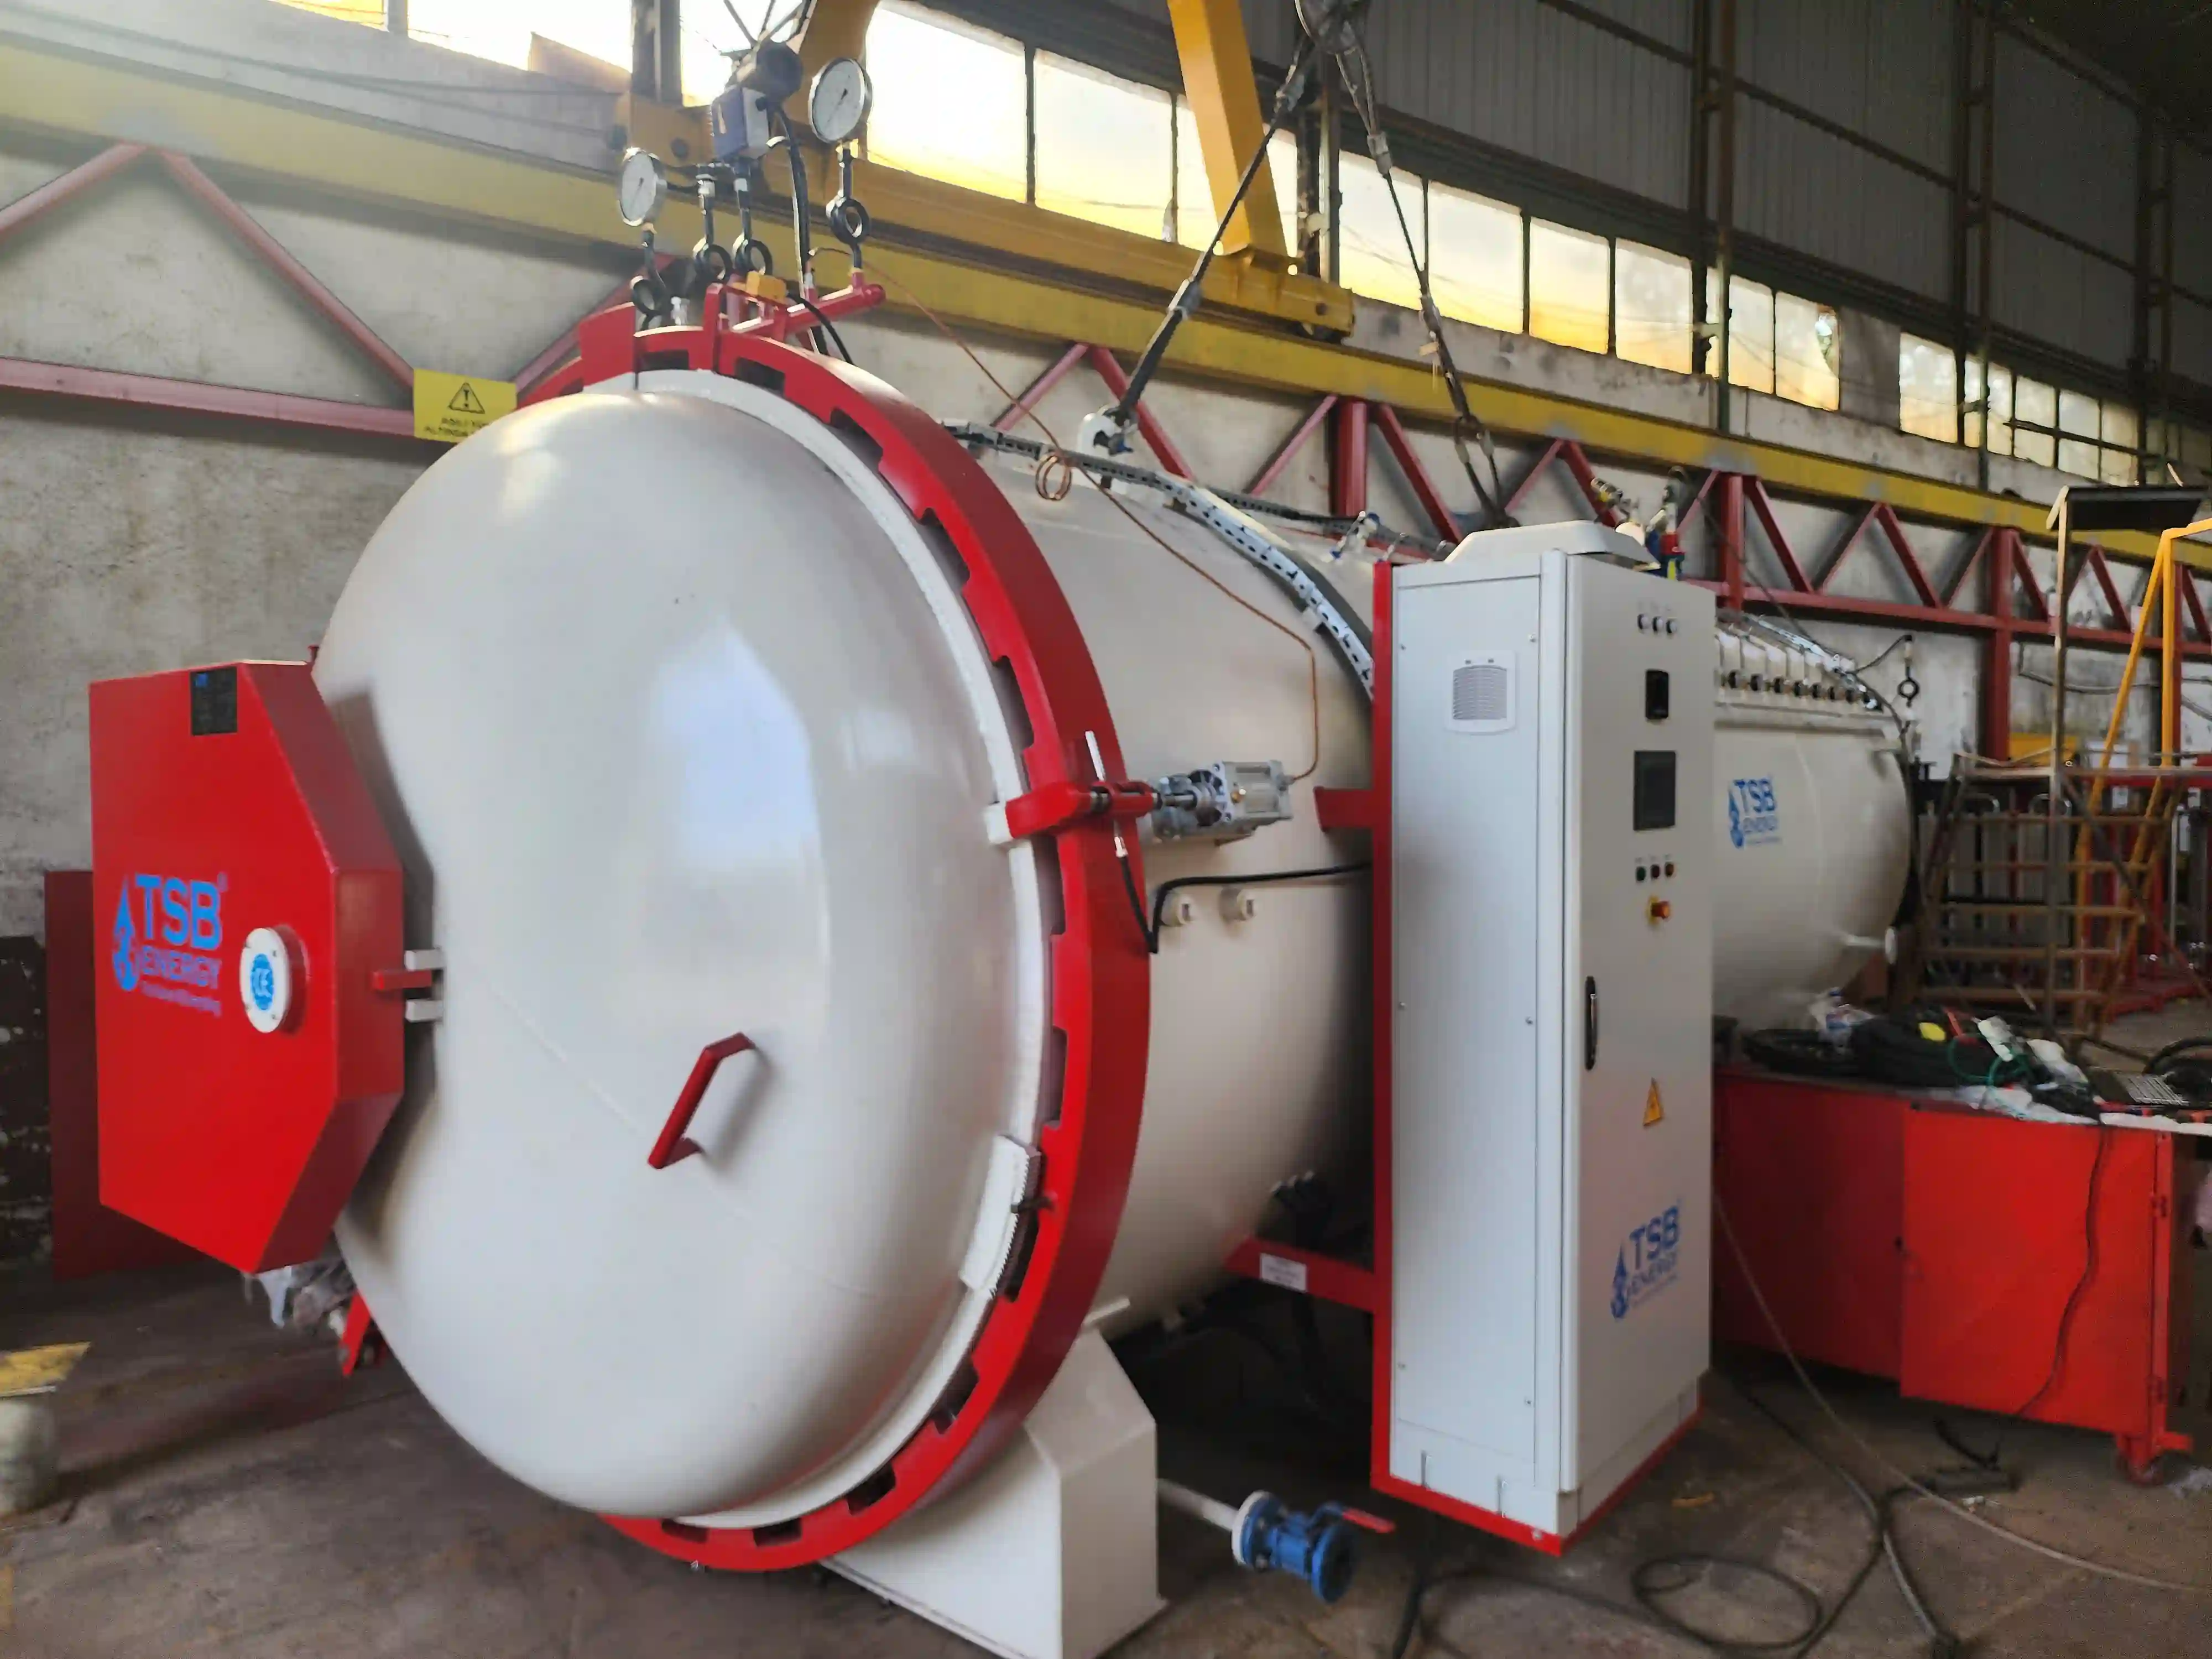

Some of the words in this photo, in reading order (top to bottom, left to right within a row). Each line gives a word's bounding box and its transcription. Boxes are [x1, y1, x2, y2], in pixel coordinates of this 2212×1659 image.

[1734, 779, 1776, 814] TSB
[135, 873, 222, 951] TSB
[140, 945, 222, 989] ENERGY
[1629, 1206, 1679, 1270] TSB
